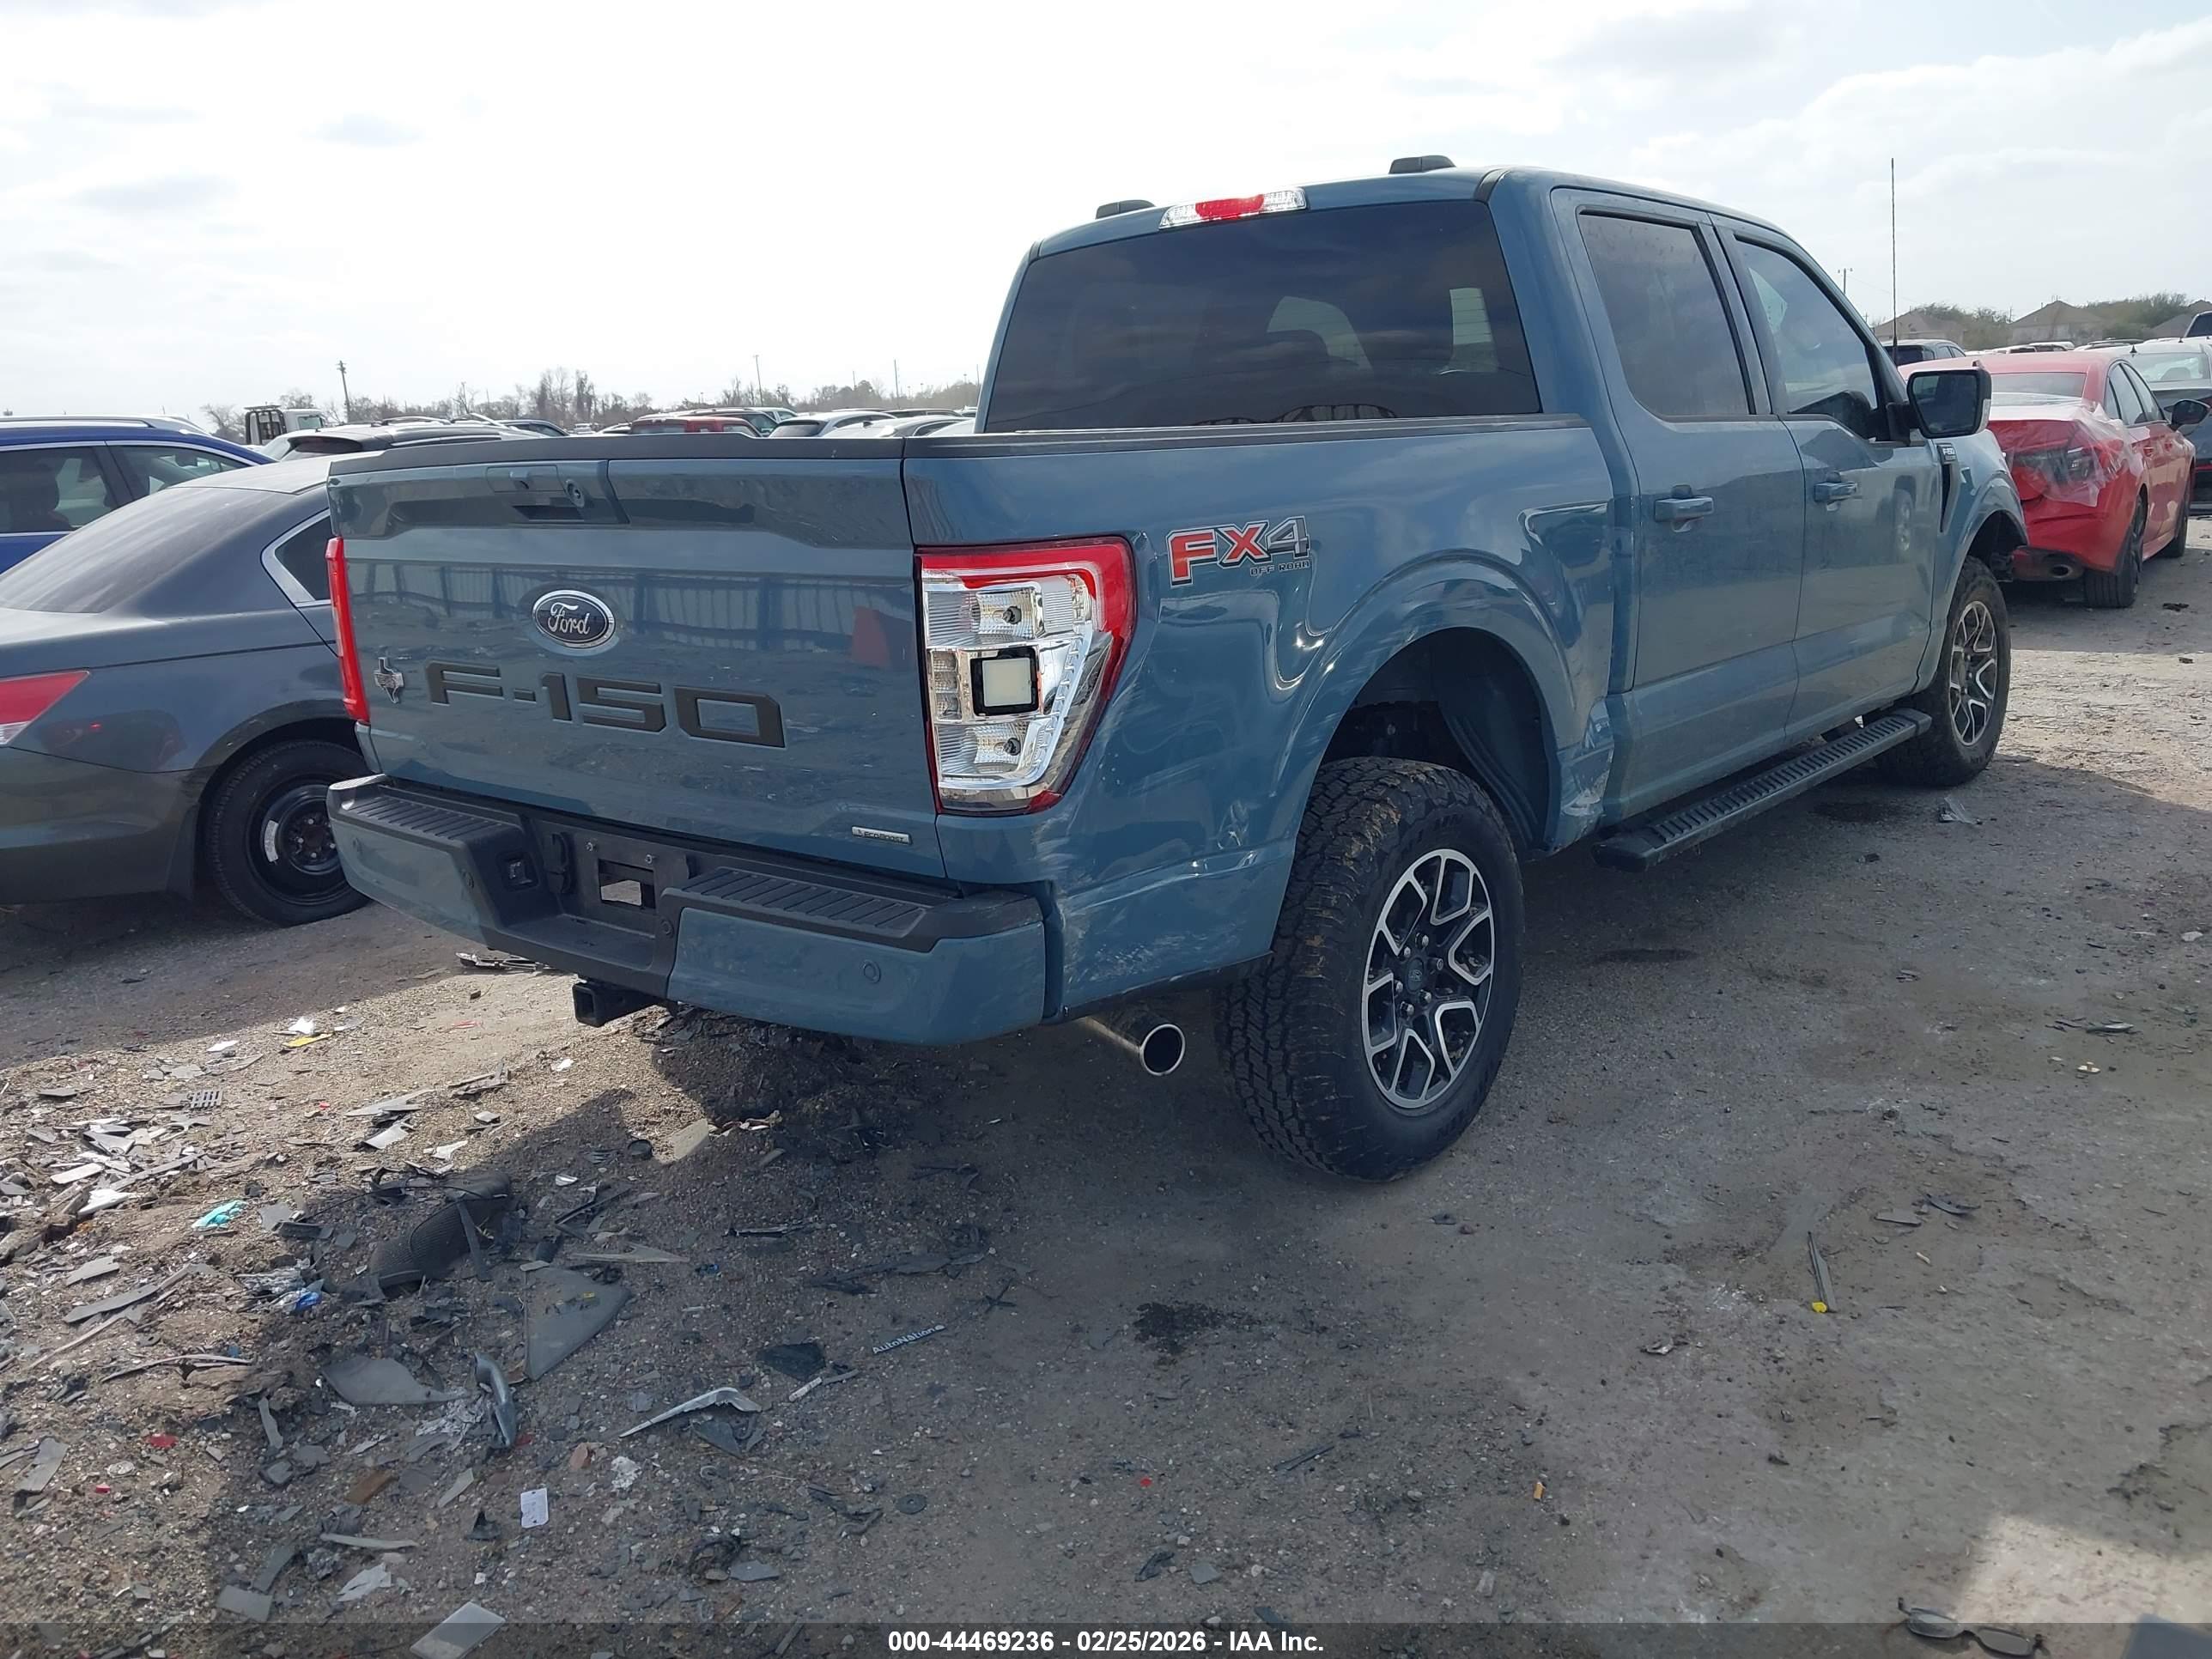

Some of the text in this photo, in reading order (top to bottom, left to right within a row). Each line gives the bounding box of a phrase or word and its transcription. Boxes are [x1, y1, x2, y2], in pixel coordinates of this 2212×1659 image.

[1165, 515, 1311, 588] FX4
[1250, 560, 1310, 576] OFF ROAD
[548, 602, 591, 635] Ford
[426, 660, 786, 748] F-150
[872, 1328, 935, 1354] AutoNation
